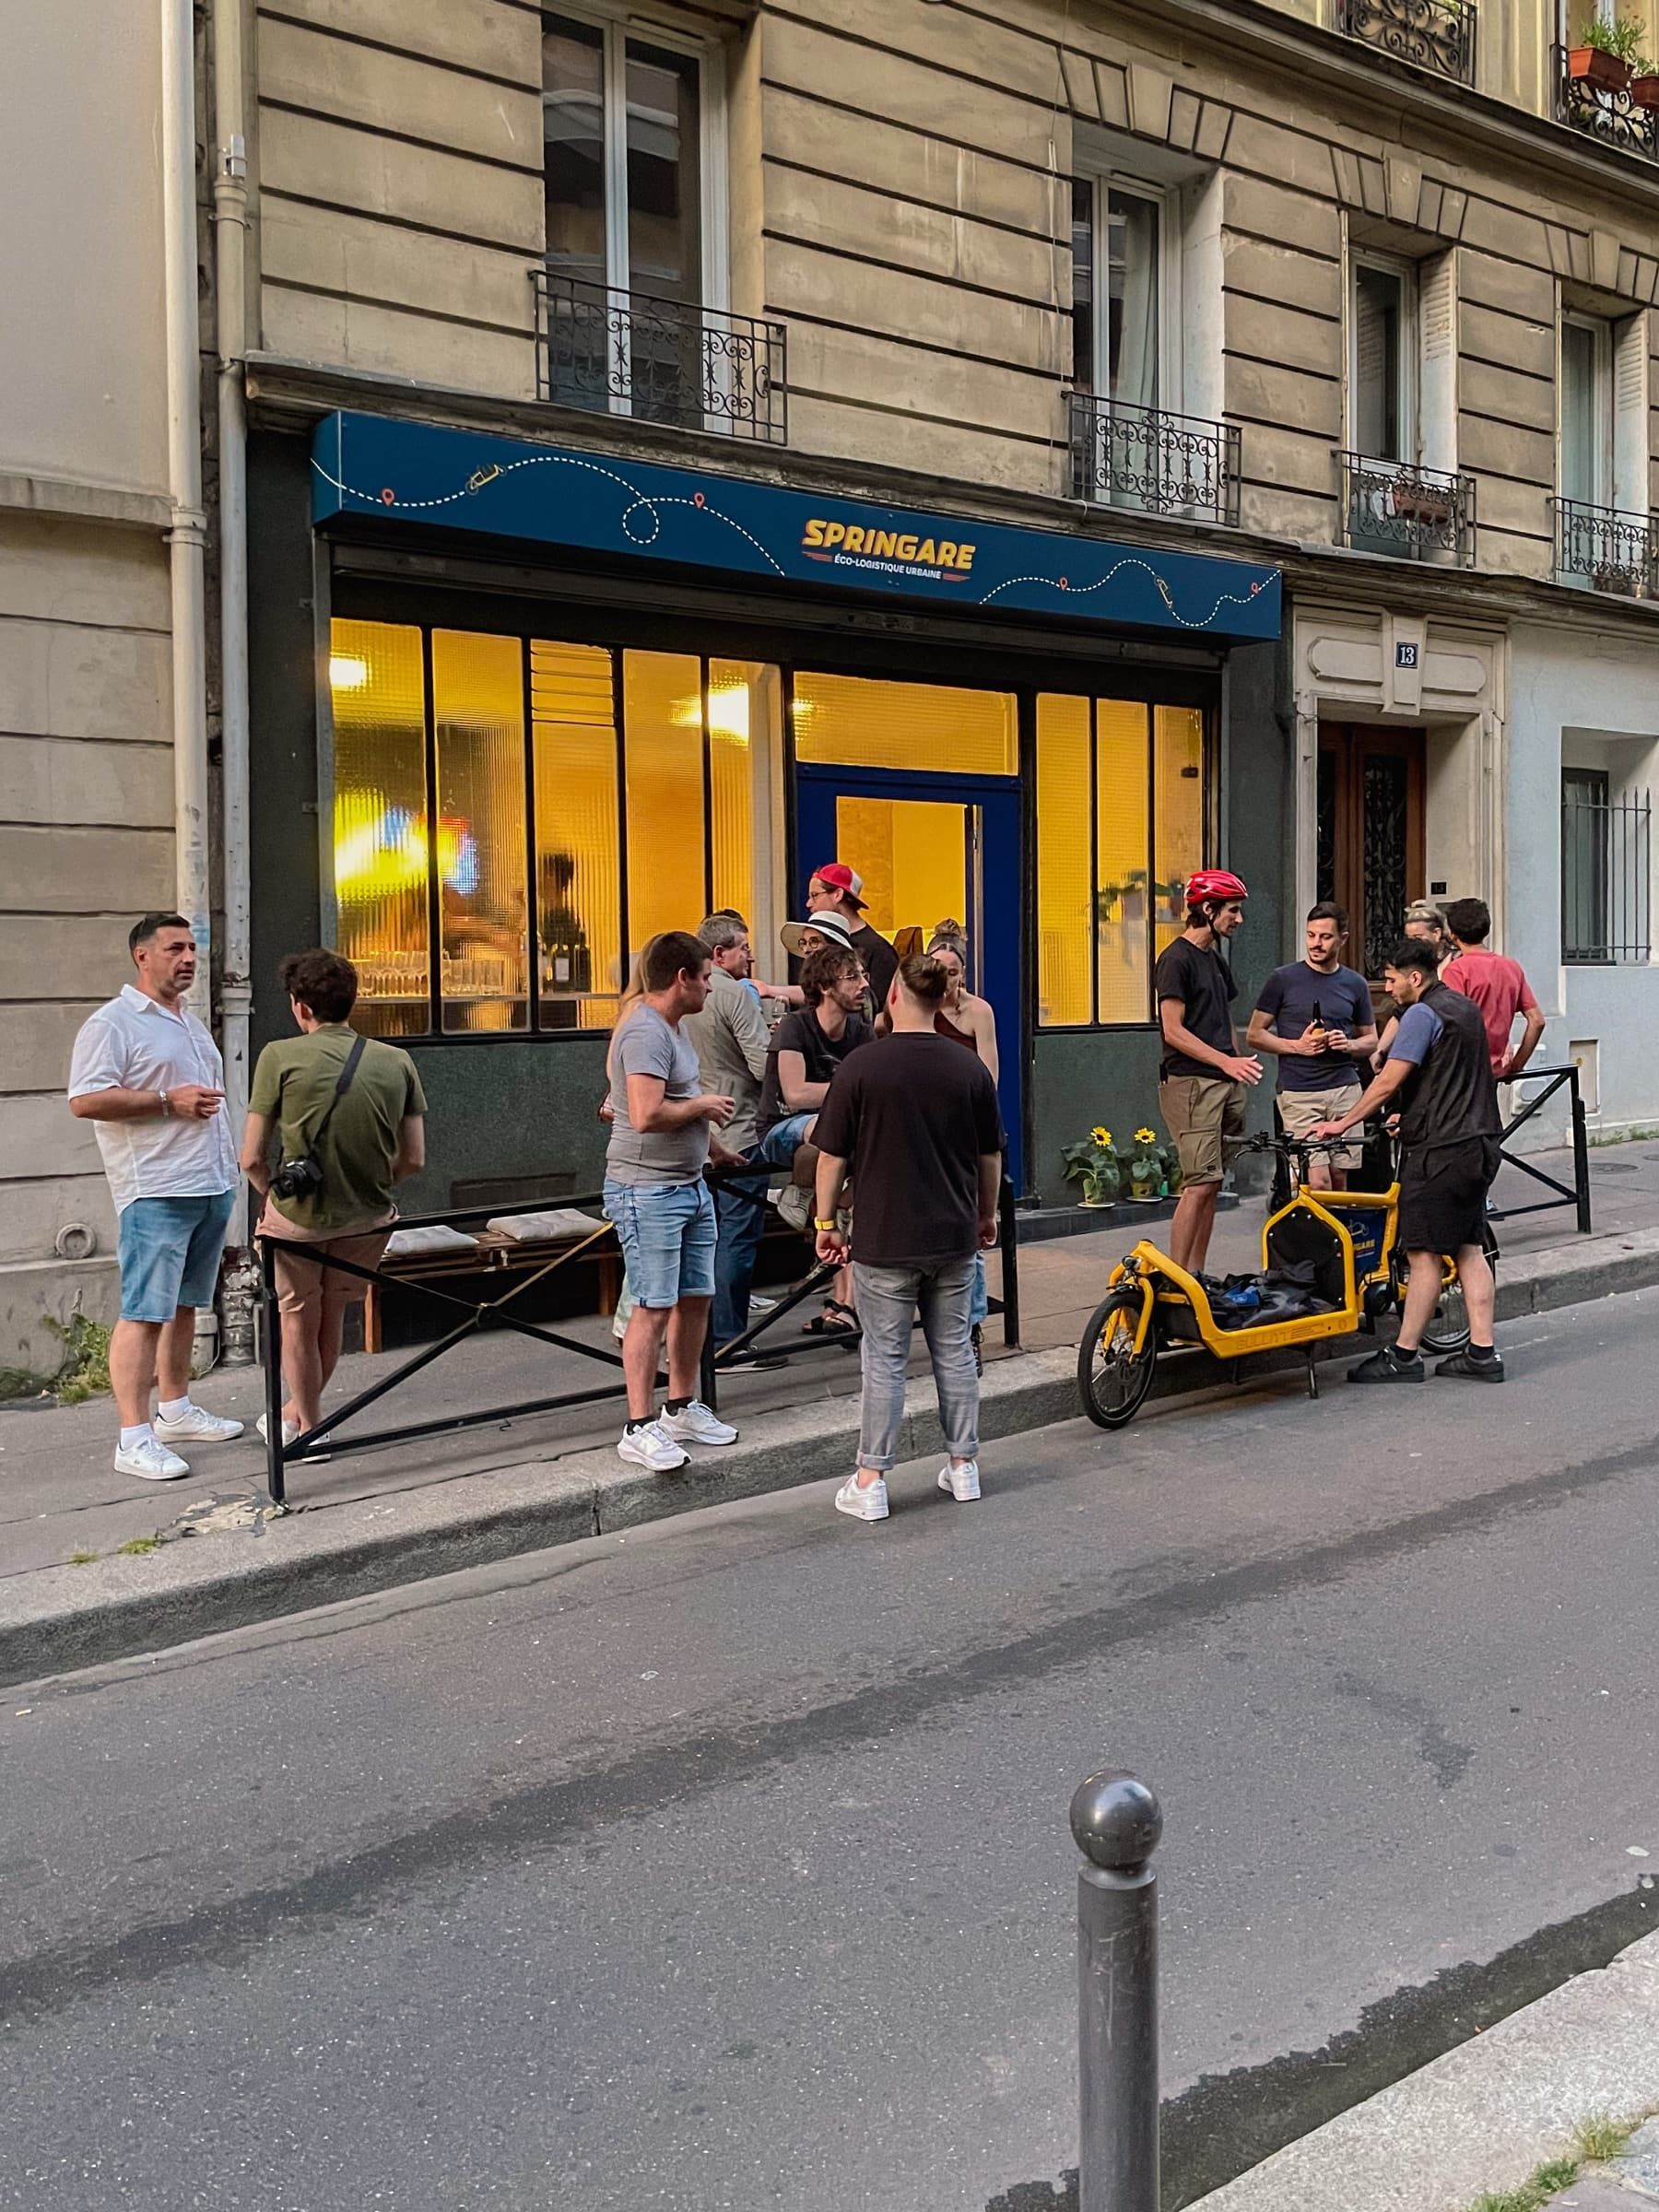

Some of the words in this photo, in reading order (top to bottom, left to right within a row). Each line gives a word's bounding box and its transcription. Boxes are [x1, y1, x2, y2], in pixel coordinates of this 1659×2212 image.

[801, 519, 976, 570] SPRINGARE
[834, 553, 905, 574] ÉCO-LOGISTIQUE
[905, 565, 942, 580] URBAINE
[1400, 646, 1415, 665] 13
